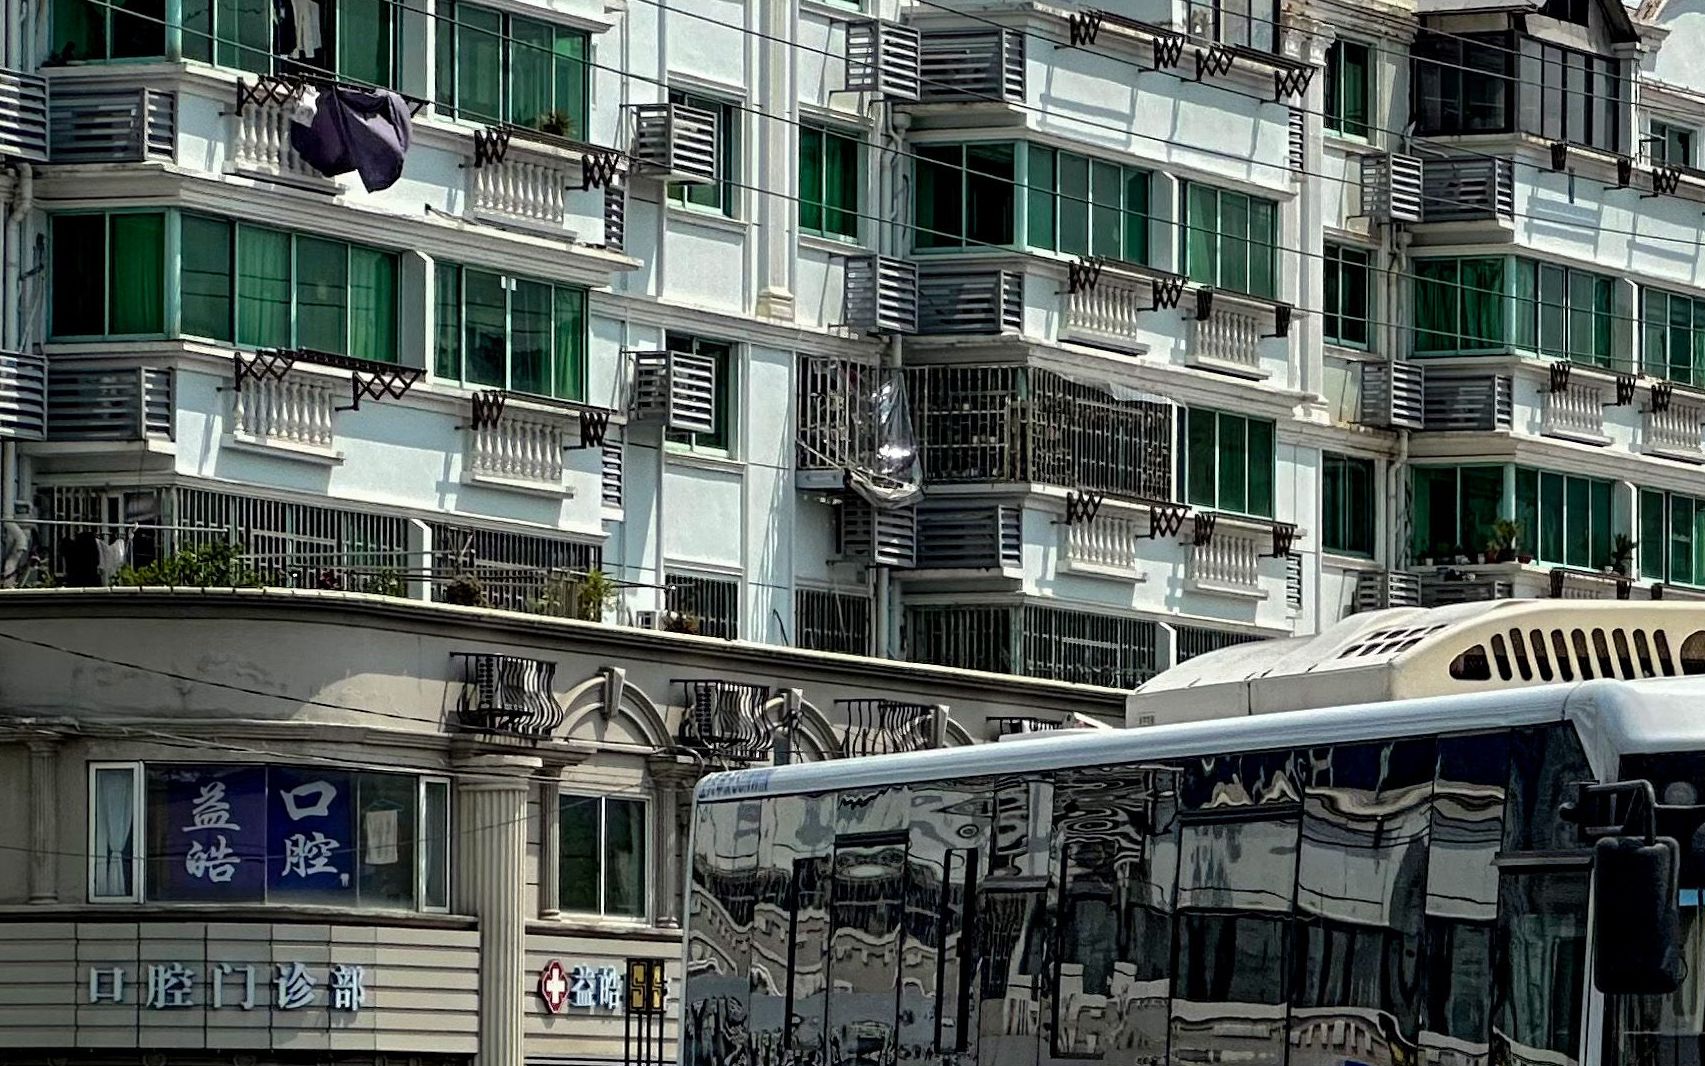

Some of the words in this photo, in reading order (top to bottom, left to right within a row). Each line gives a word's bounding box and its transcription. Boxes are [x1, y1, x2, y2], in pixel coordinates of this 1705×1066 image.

[279, 780, 341, 878] 口腔
[89, 961, 368, 1011] 口腔门诊部
